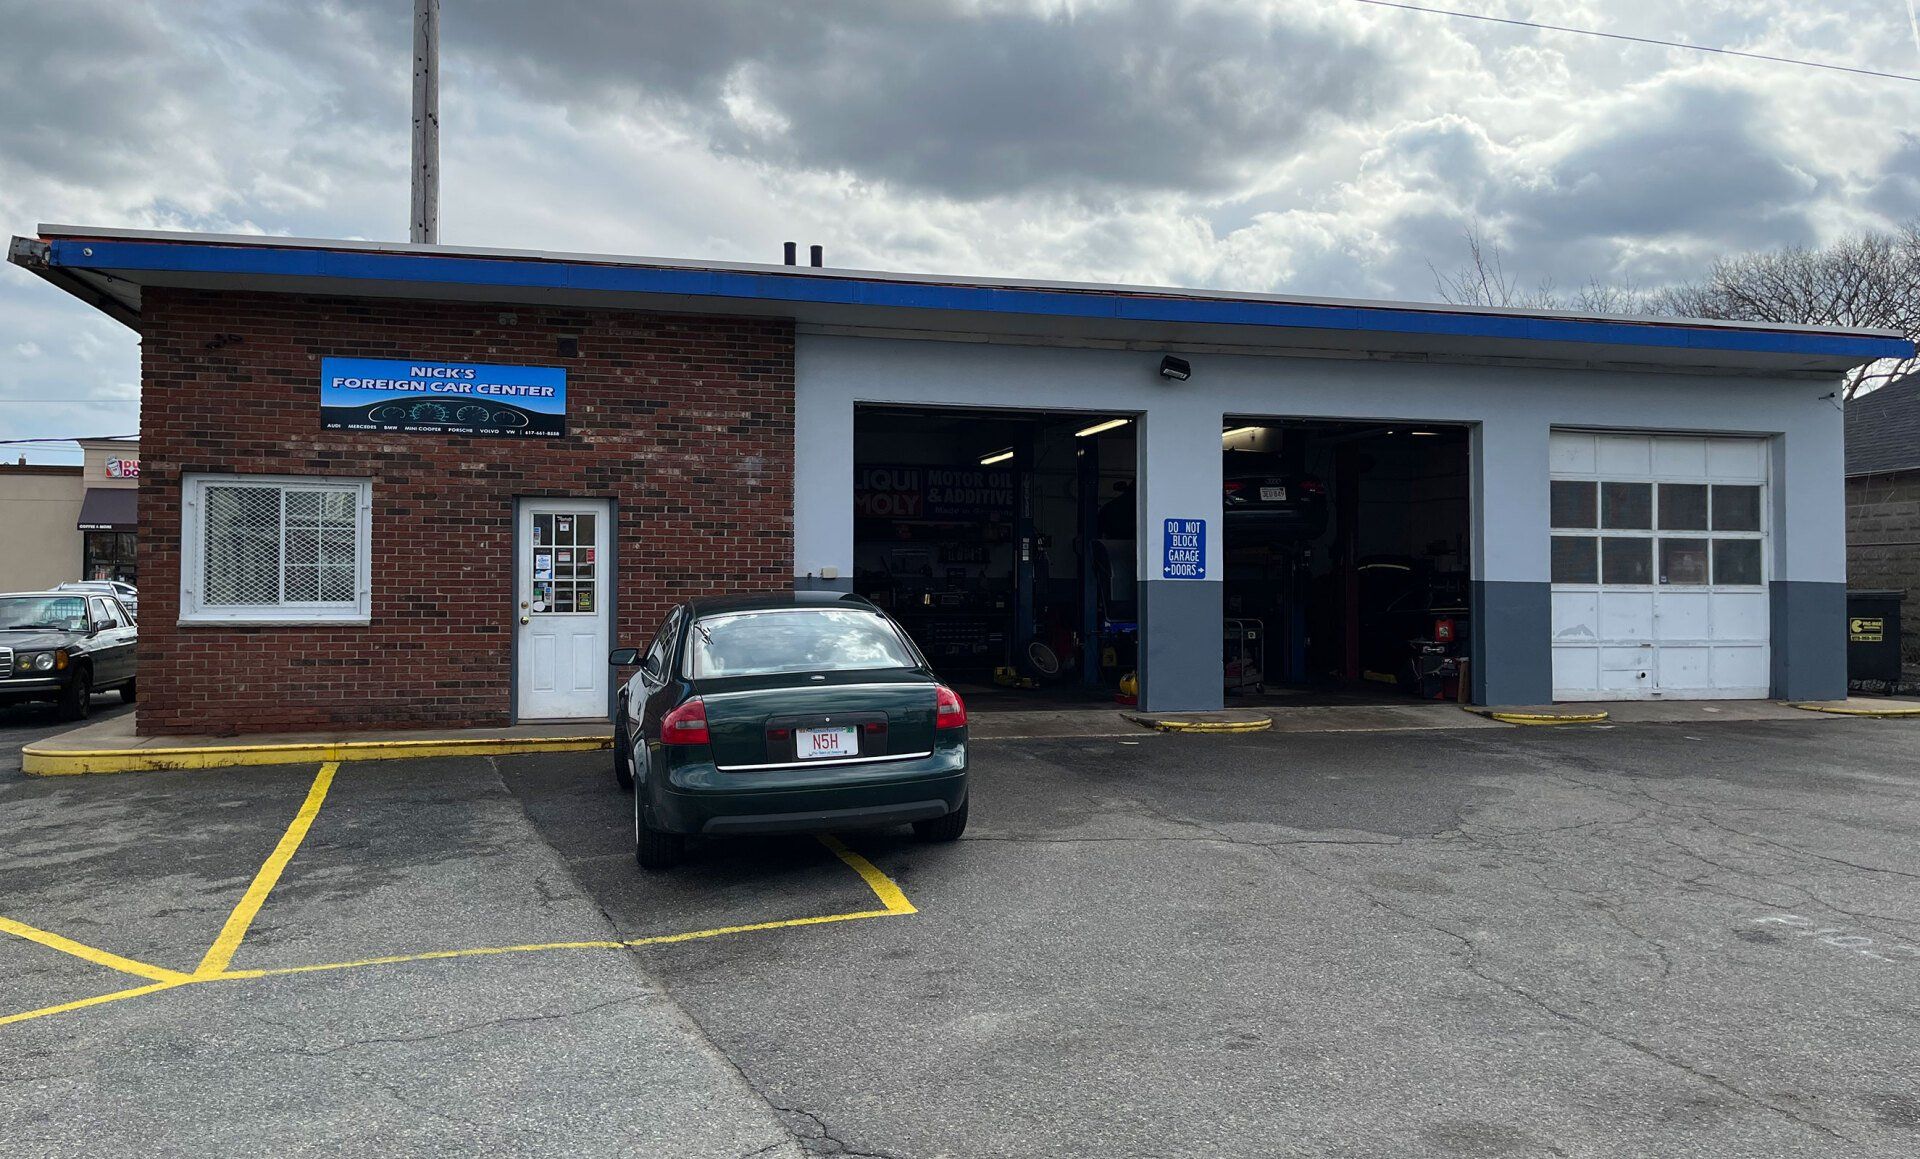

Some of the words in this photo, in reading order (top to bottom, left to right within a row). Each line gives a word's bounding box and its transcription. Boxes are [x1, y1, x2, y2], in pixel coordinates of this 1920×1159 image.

[410, 366, 475, 379] NICK'S
[332, 377, 425, 391] FOREIGN
[430, 382, 472, 393] CAR
[476, 384, 555, 397] CENTER
[928, 470, 984, 487] MOTOR
[988, 472, 1013, 488] OIL
[927, 488, 942, 503] &
[1168, 522, 1178, 533] DO
[1185, 522, 1200, 533] NOT
[1172, 535, 1198, 547] BLOCK
[1168, 550, 1200, 562] GARAGE
[1171, 564, 1197, 576] DOORS
[813, 733, 838, 750] N5H
